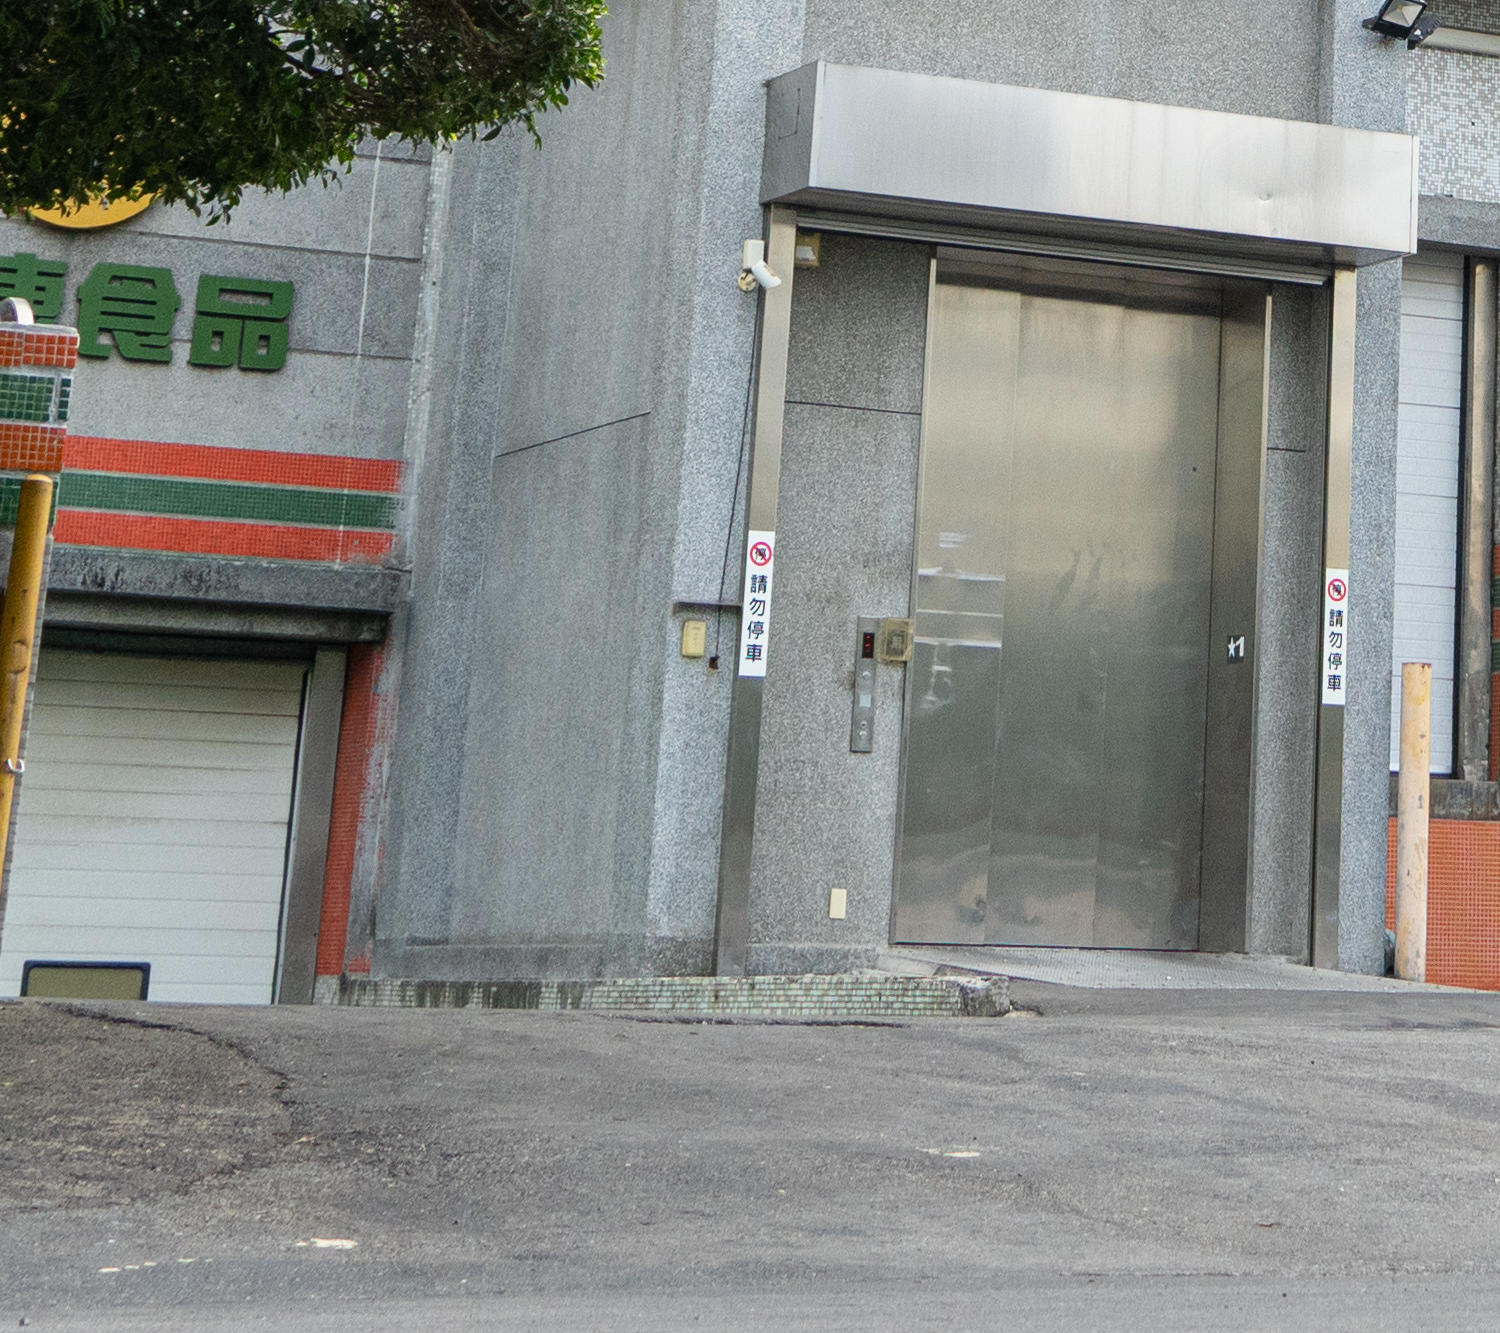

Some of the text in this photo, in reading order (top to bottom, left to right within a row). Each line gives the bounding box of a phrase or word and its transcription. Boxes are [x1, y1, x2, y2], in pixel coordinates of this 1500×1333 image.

[745, 574, 768, 663] 請勿停車
[1327, 609, 1344, 693] 請勿停車
